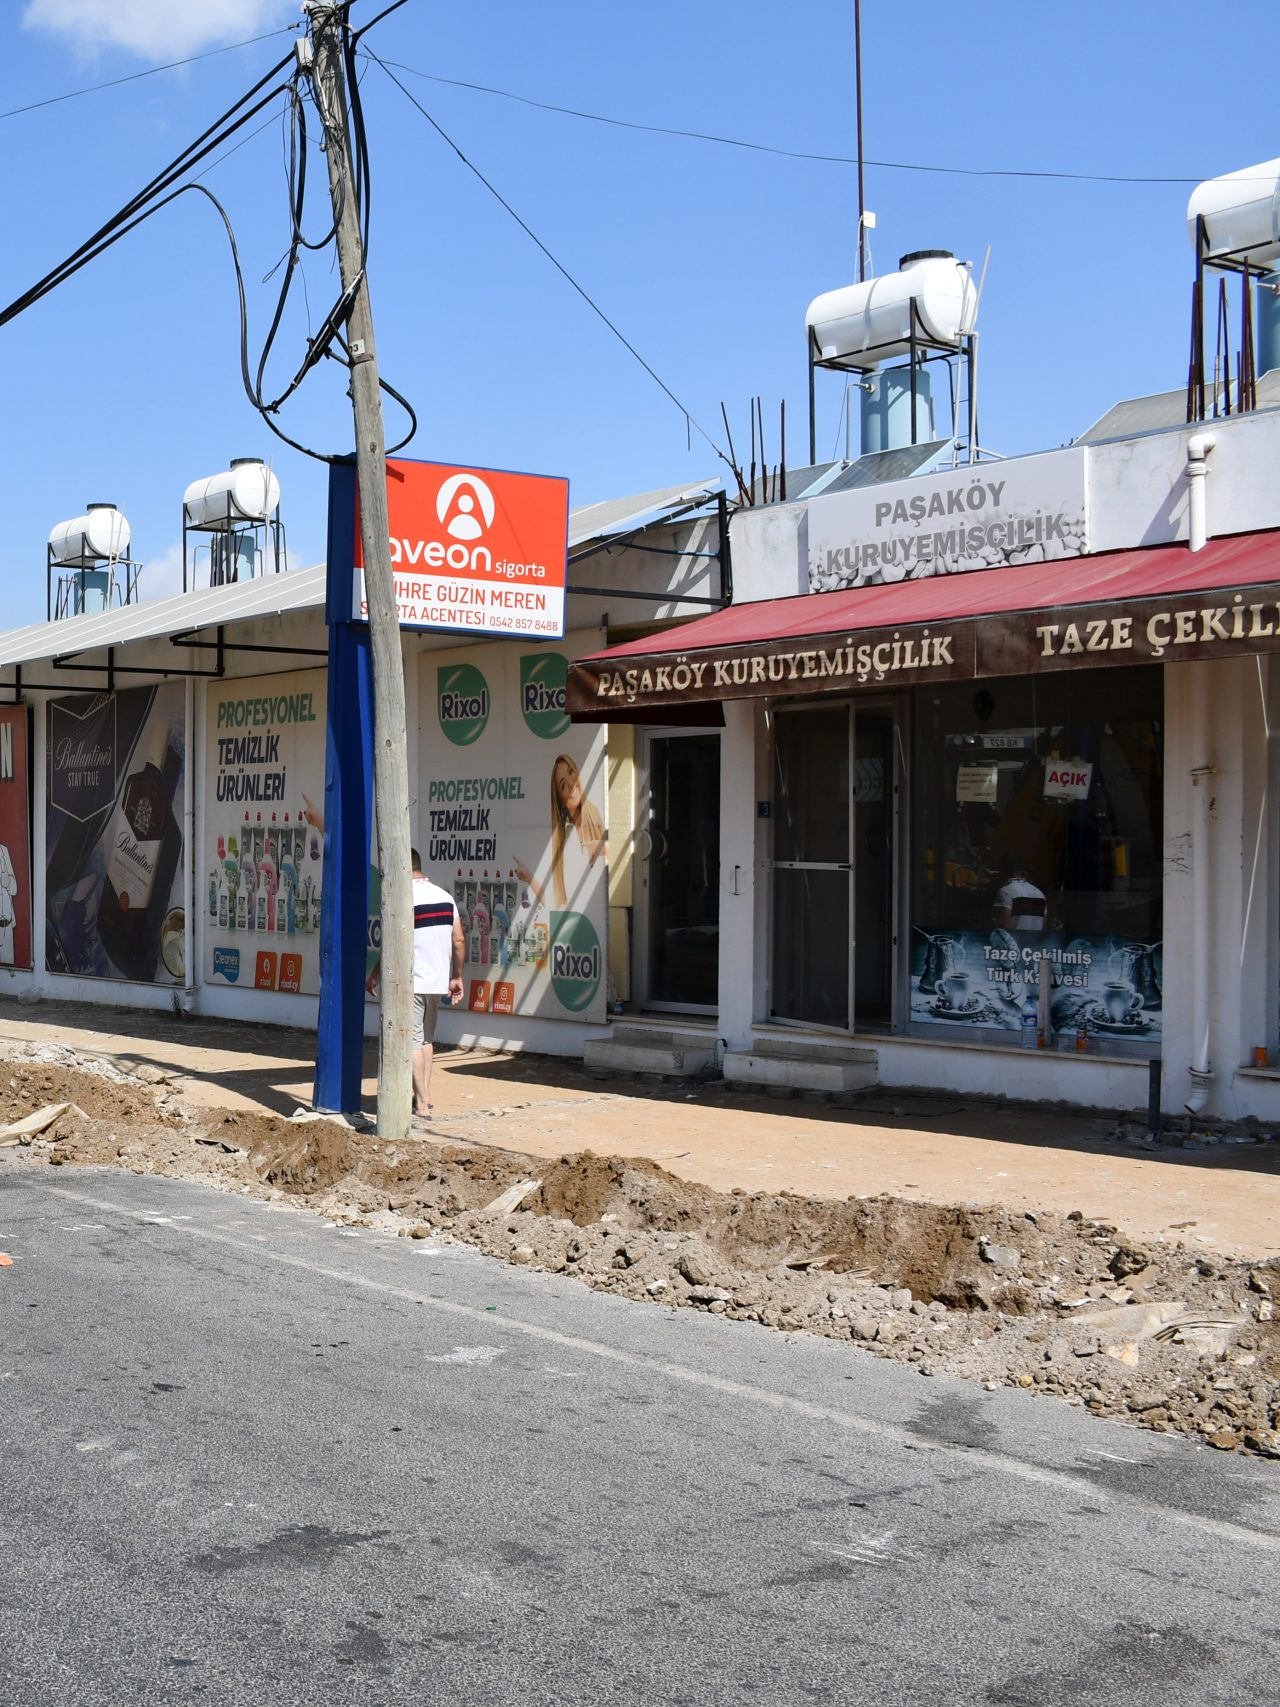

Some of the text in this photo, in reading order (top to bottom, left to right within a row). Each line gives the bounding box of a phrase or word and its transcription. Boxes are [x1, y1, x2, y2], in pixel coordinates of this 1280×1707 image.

[875, 478, 1006, 527] PAŞAKÖY
[826, 509, 1067, 573] KURUYEMİŞÇİLİK
[495, 559, 545, 579] sigorta
[437, 581, 486, 606] GÜZİN
[491, 590, 546, 611] MEREN
[421, 607, 486, 626] ACENTESİ
[489, 617, 512, 629] 0542
[515, 619, 533, 630] 857
[534, 620, 558, 632] 8488
[1036, 594, 1280, 657] TAZE ÇEKİL
[597, 629, 954, 702] PAŞAKÖY KURUYEMİŞÇİLİK
[217, 693, 316, 728] PROFESYONEL
[441, 689, 487, 720] Rixol
[524, 683, 567, 712] Rixo
[55, 737, 112, 770] Ballantine's
[218, 728, 280, 765] TEMİZLİK
[68, 770, 100, 787] STAY TRUE
[216, 766, 286, 802] ÜRÜNLERİ
[429, 776, 525, 803] PROFESYONEL
[1048, 770, 1087, 787] AÇIK
[430, 804, 490, 832] TEMİZLİK
[429, 833, 497, 861] ÜRÜNLERİ
[553, 944, 598, 979] Rixol
[983, 945, 1092, 969] Taze Çekilmiş
[986, 967, 1020, 983] Türk
